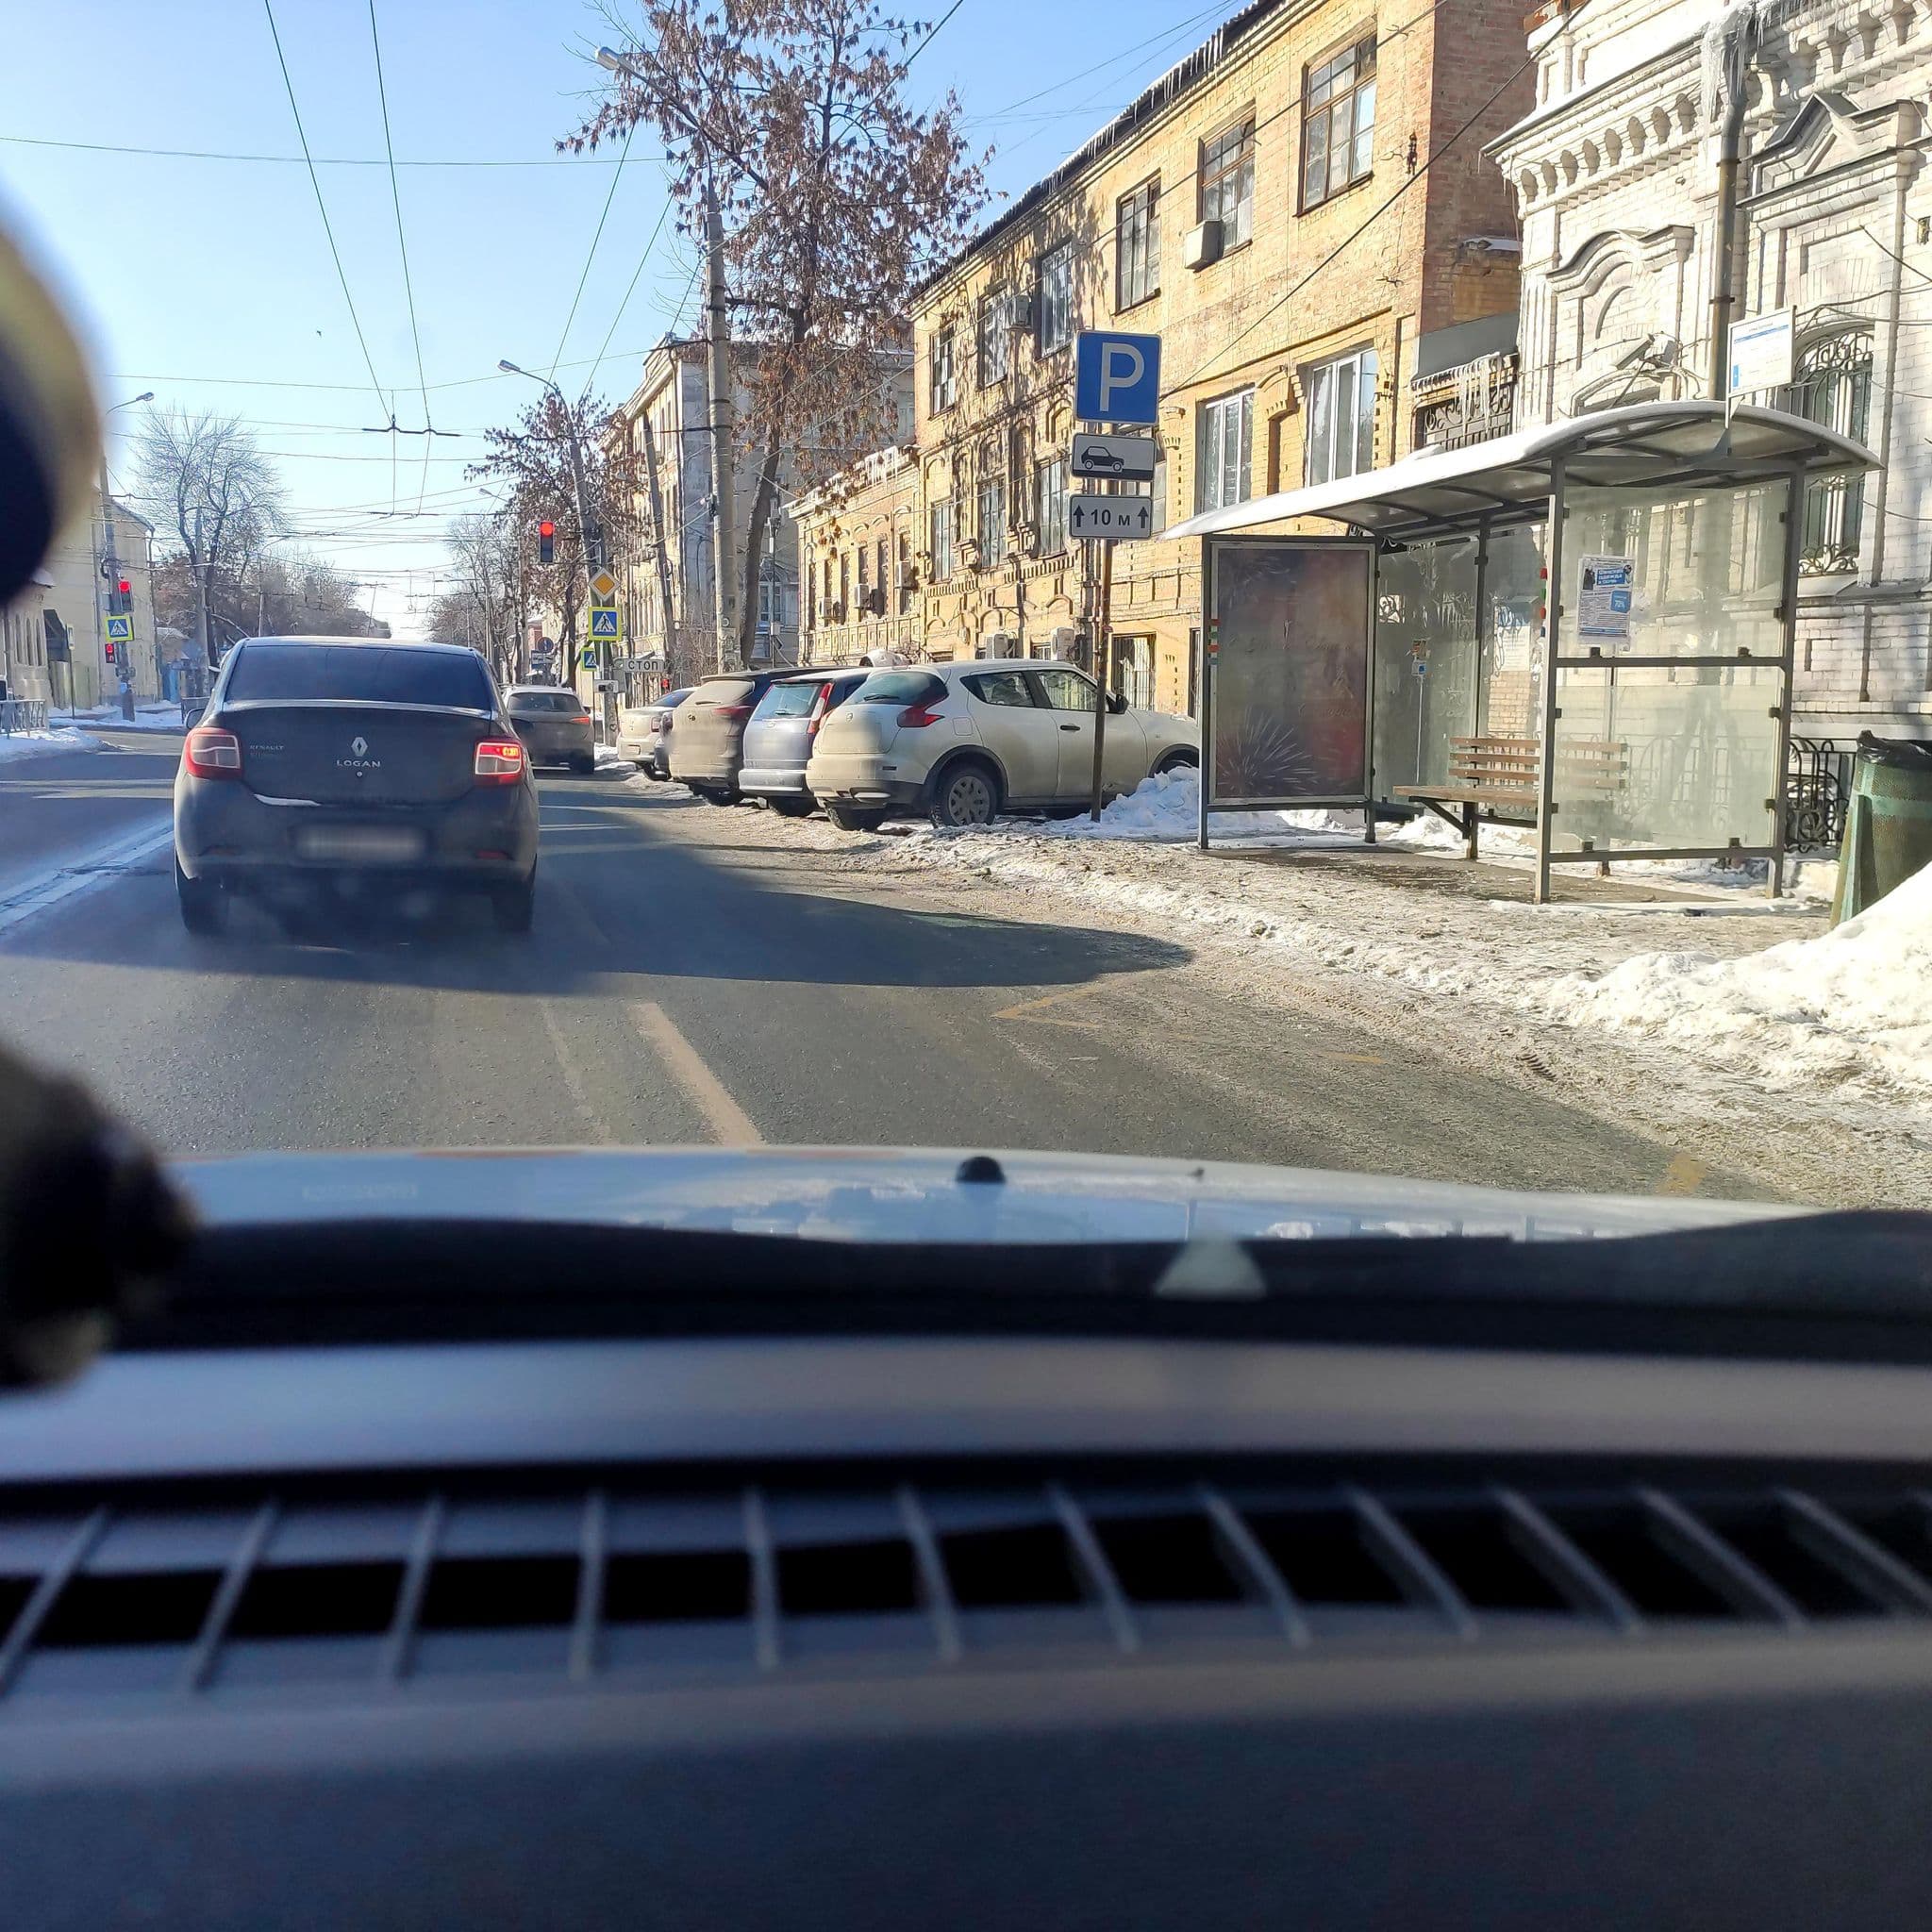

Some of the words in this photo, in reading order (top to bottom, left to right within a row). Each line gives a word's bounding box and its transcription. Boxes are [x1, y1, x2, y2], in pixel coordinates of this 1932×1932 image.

[1099, 341, 1145, 412] P
[1091, 508, 1111, 525] 10
[627, 660, 658, 671] СТОП
[336, 759, 381, 768] LOGAN
